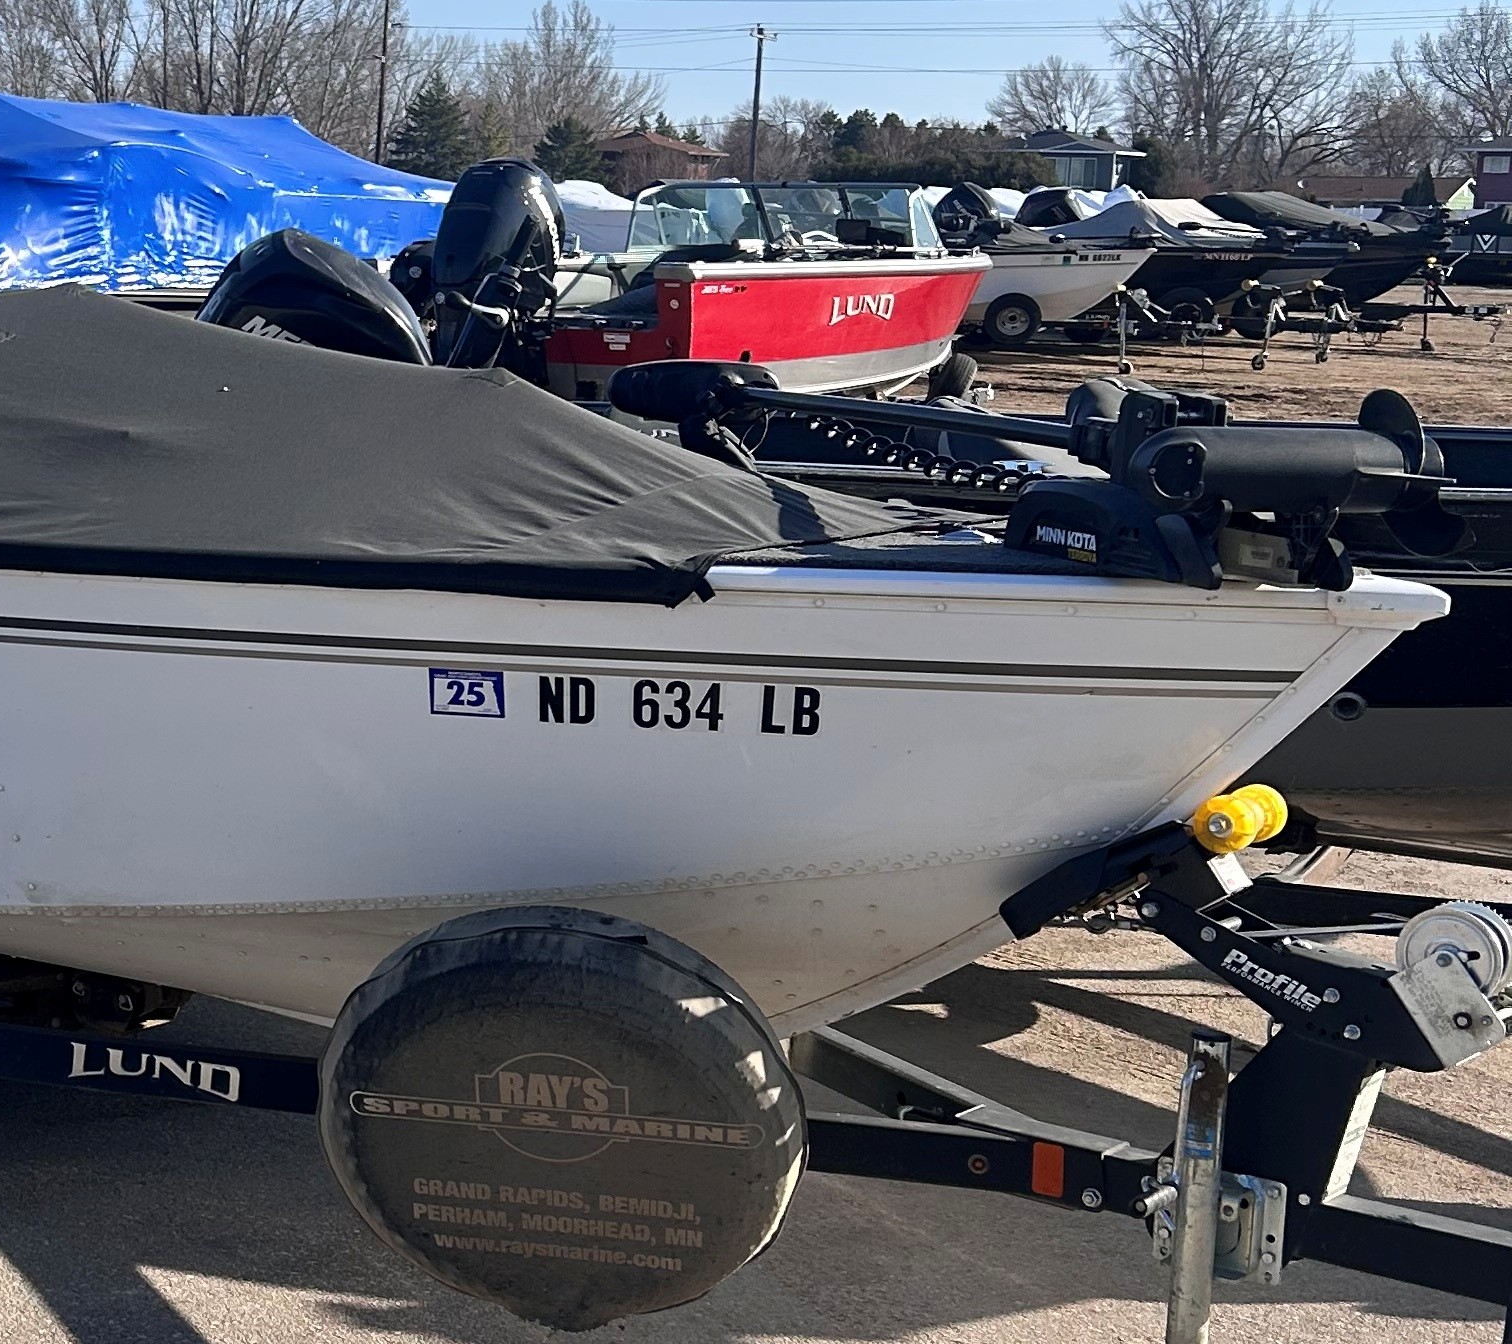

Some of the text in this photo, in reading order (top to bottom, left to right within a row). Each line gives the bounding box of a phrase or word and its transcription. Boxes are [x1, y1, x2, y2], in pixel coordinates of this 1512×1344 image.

[828, 293, 895, 326] LUND
[1036, 525, 1096, 552] MINN KOTA
[446, 680, 486, 707] 25
[539, 675, 821, 736] ND 634 LB
[1220, 961, 1313, 1013] PERFORMANCE WINCH
[1223, 948, 1322, 1009] Profile
[67, 1041, 241, 1102] LUND
[498, 1071, 609, 1112] RAY'S
[362, 1097, 751, 1145] SPORT & MARINE
[413, 1177, 701, 1225] GRAND RAPIDS, BEMIDJI,
[412, 1202, 703, 1249] PERHAM, MOORHEAD, MN
[433, 1233, 682, 1272] www.raysmarine.com
